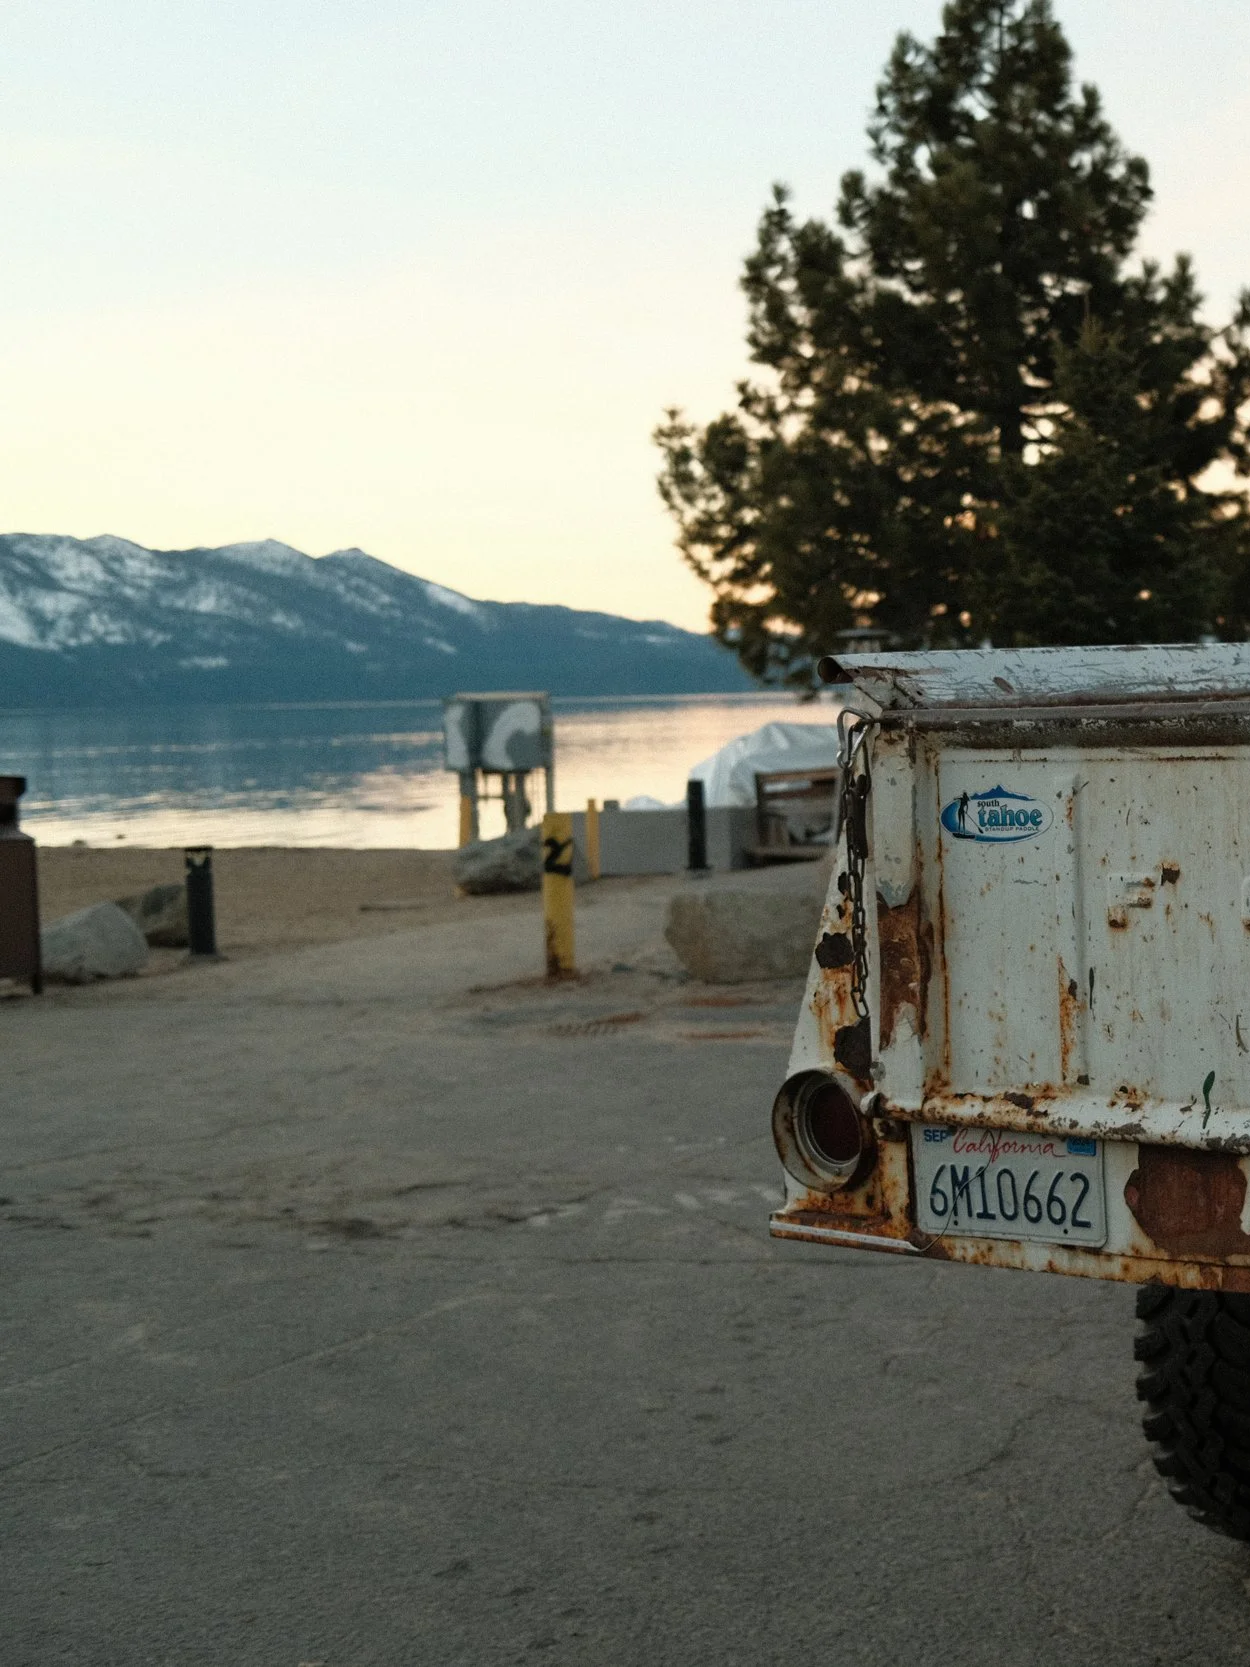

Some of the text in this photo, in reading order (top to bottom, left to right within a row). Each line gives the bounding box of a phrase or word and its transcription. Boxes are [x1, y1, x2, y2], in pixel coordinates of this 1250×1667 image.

[977, 799, 1000, 808] south
[978, 804, 1043, 827] tahoe
[924, 1129, 948, 1143] SEP
[953, 1126, 1066, 1163] California
[929, 1163, 1092, 1229] 6M10662
